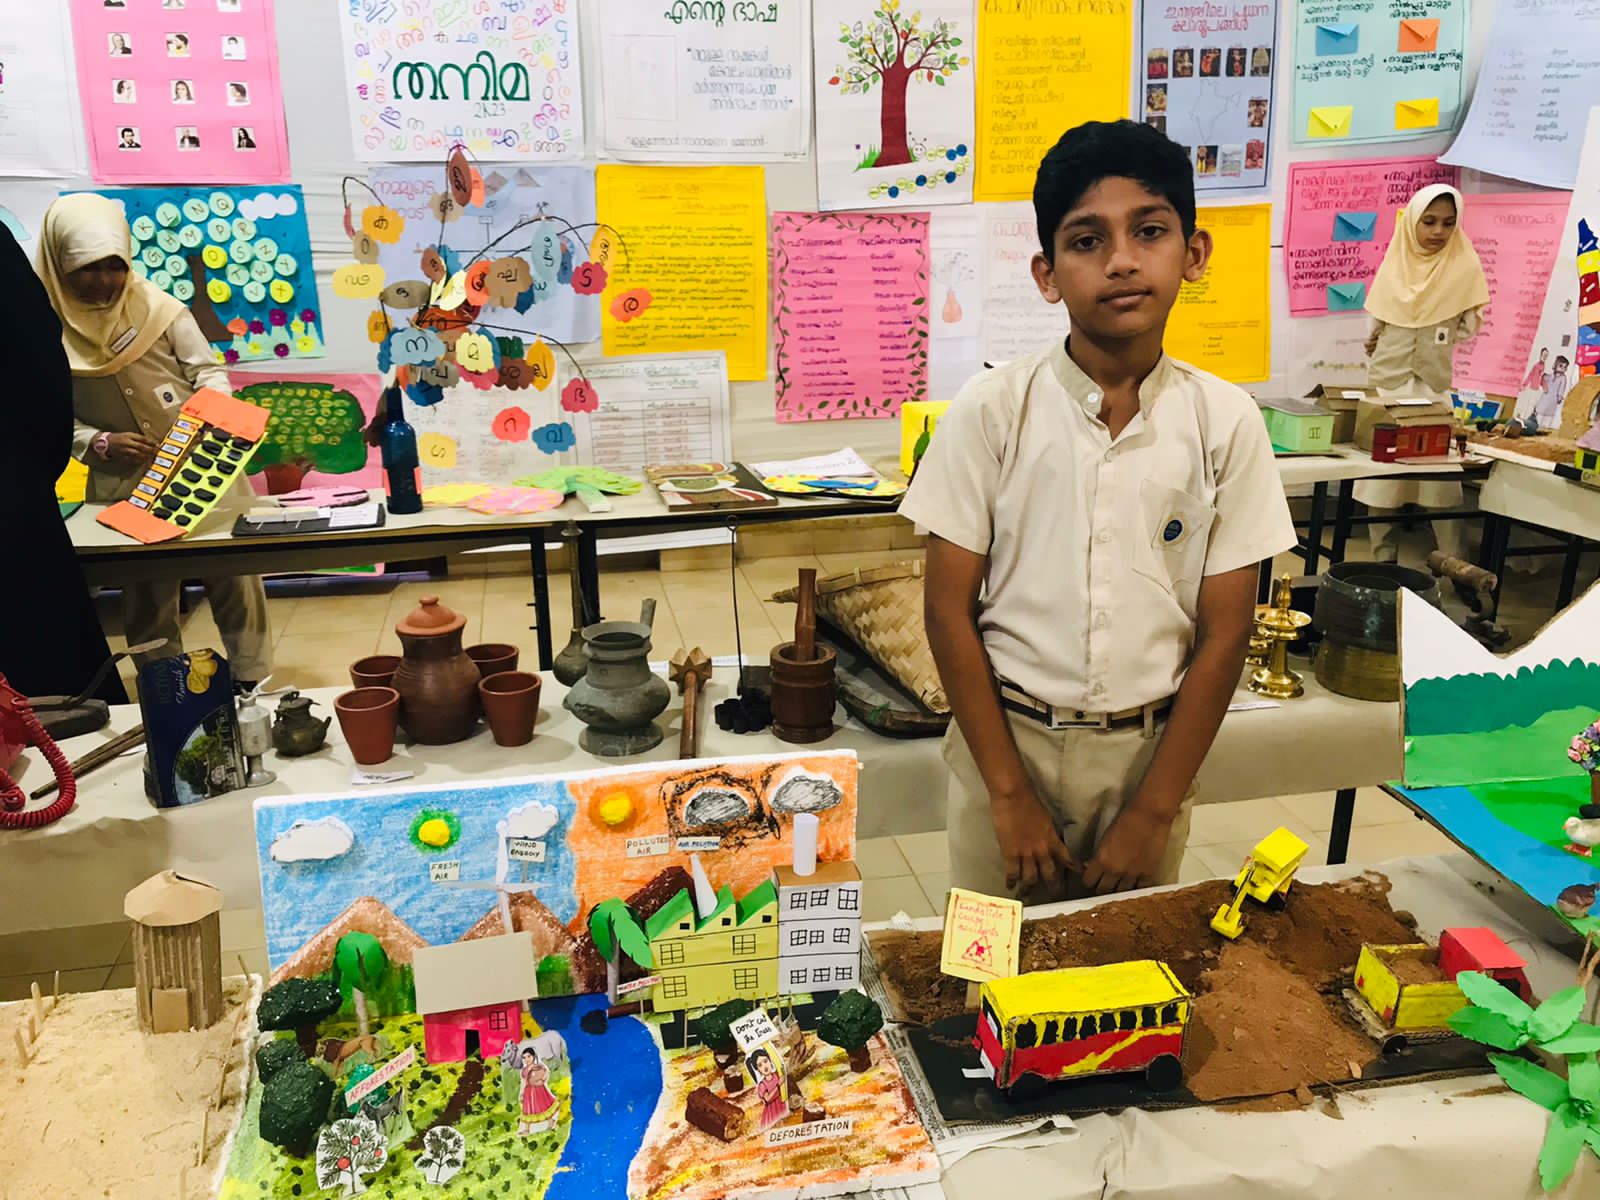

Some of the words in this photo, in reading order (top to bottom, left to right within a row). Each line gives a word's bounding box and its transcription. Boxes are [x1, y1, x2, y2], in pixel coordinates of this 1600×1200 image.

[733, 1, 777, 23] ഭാഷ
[393, 50, 530, 101] തനിമ
[513, 841, 537, 849] WIND
[510, 849, 540, 857] ENERGY
[636, 847, 652, 855] AIR
[431, 862, 459, 870] FRESH
[769, 1119, 850, 1143] DEFORESTATION
